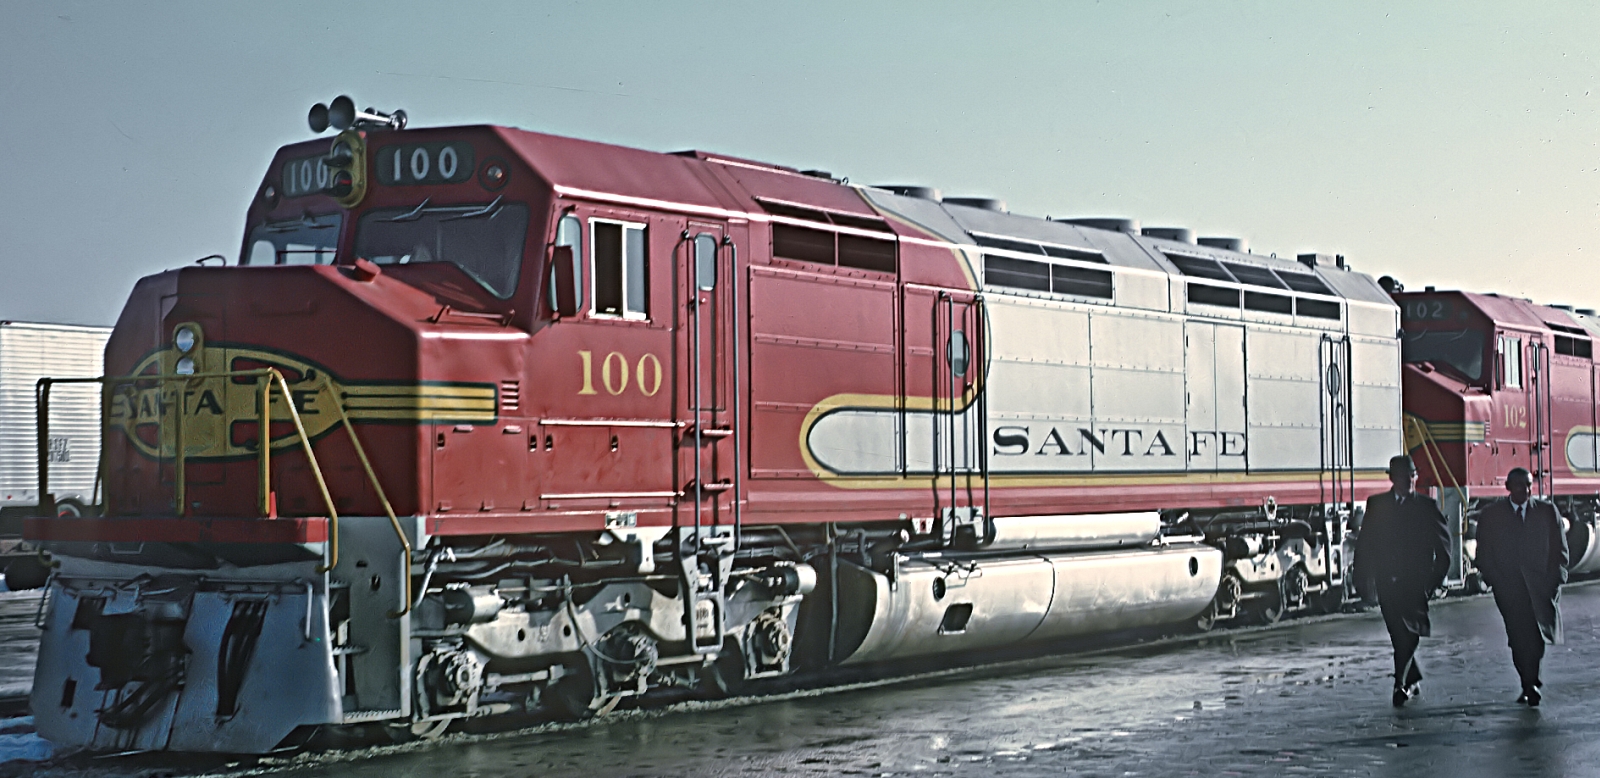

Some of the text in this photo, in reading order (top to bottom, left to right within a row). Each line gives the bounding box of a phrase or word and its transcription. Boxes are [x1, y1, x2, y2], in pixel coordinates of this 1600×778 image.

[290, 157, 328, 194] 100
[393, 146, 458, 182] 100
[1406, 302, 1443, 318] 102
[576, 349, 663, 398] 100
[127, 388, 320, 419] SANTA FE
[1503, 403, 1528, 429] 102
[992, 425, 1247, 458] SANTA FE
